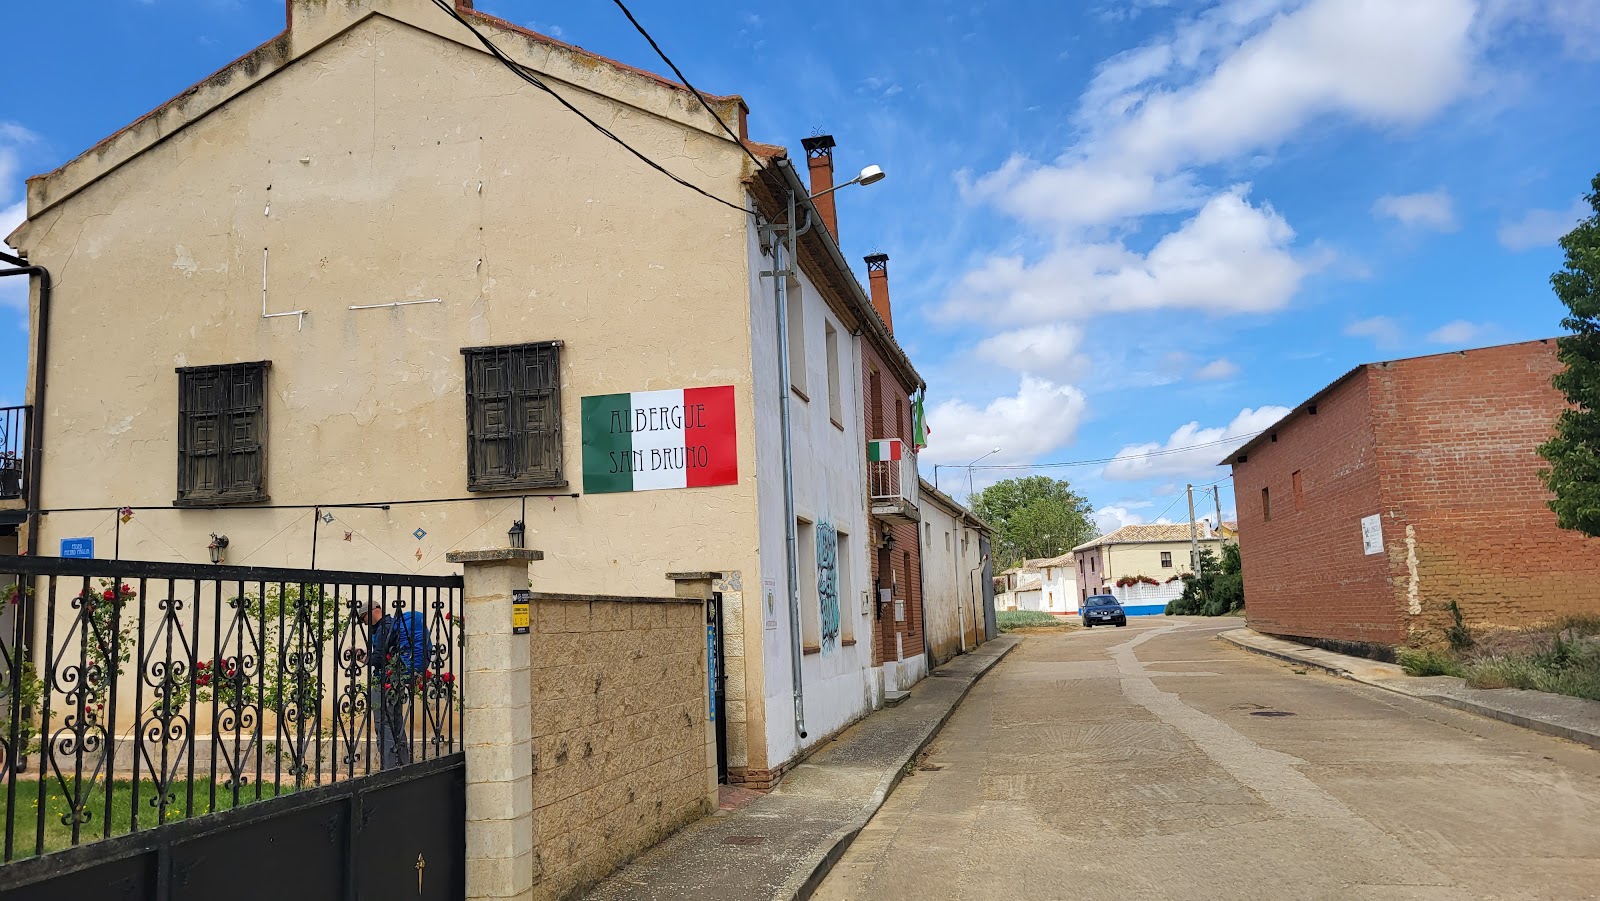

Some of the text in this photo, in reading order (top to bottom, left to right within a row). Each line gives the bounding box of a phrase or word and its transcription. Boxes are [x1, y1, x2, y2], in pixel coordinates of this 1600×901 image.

[609, 404, 706, 434] ALBERGUE
[609, 445, 708, 474] SAN BRUNO
